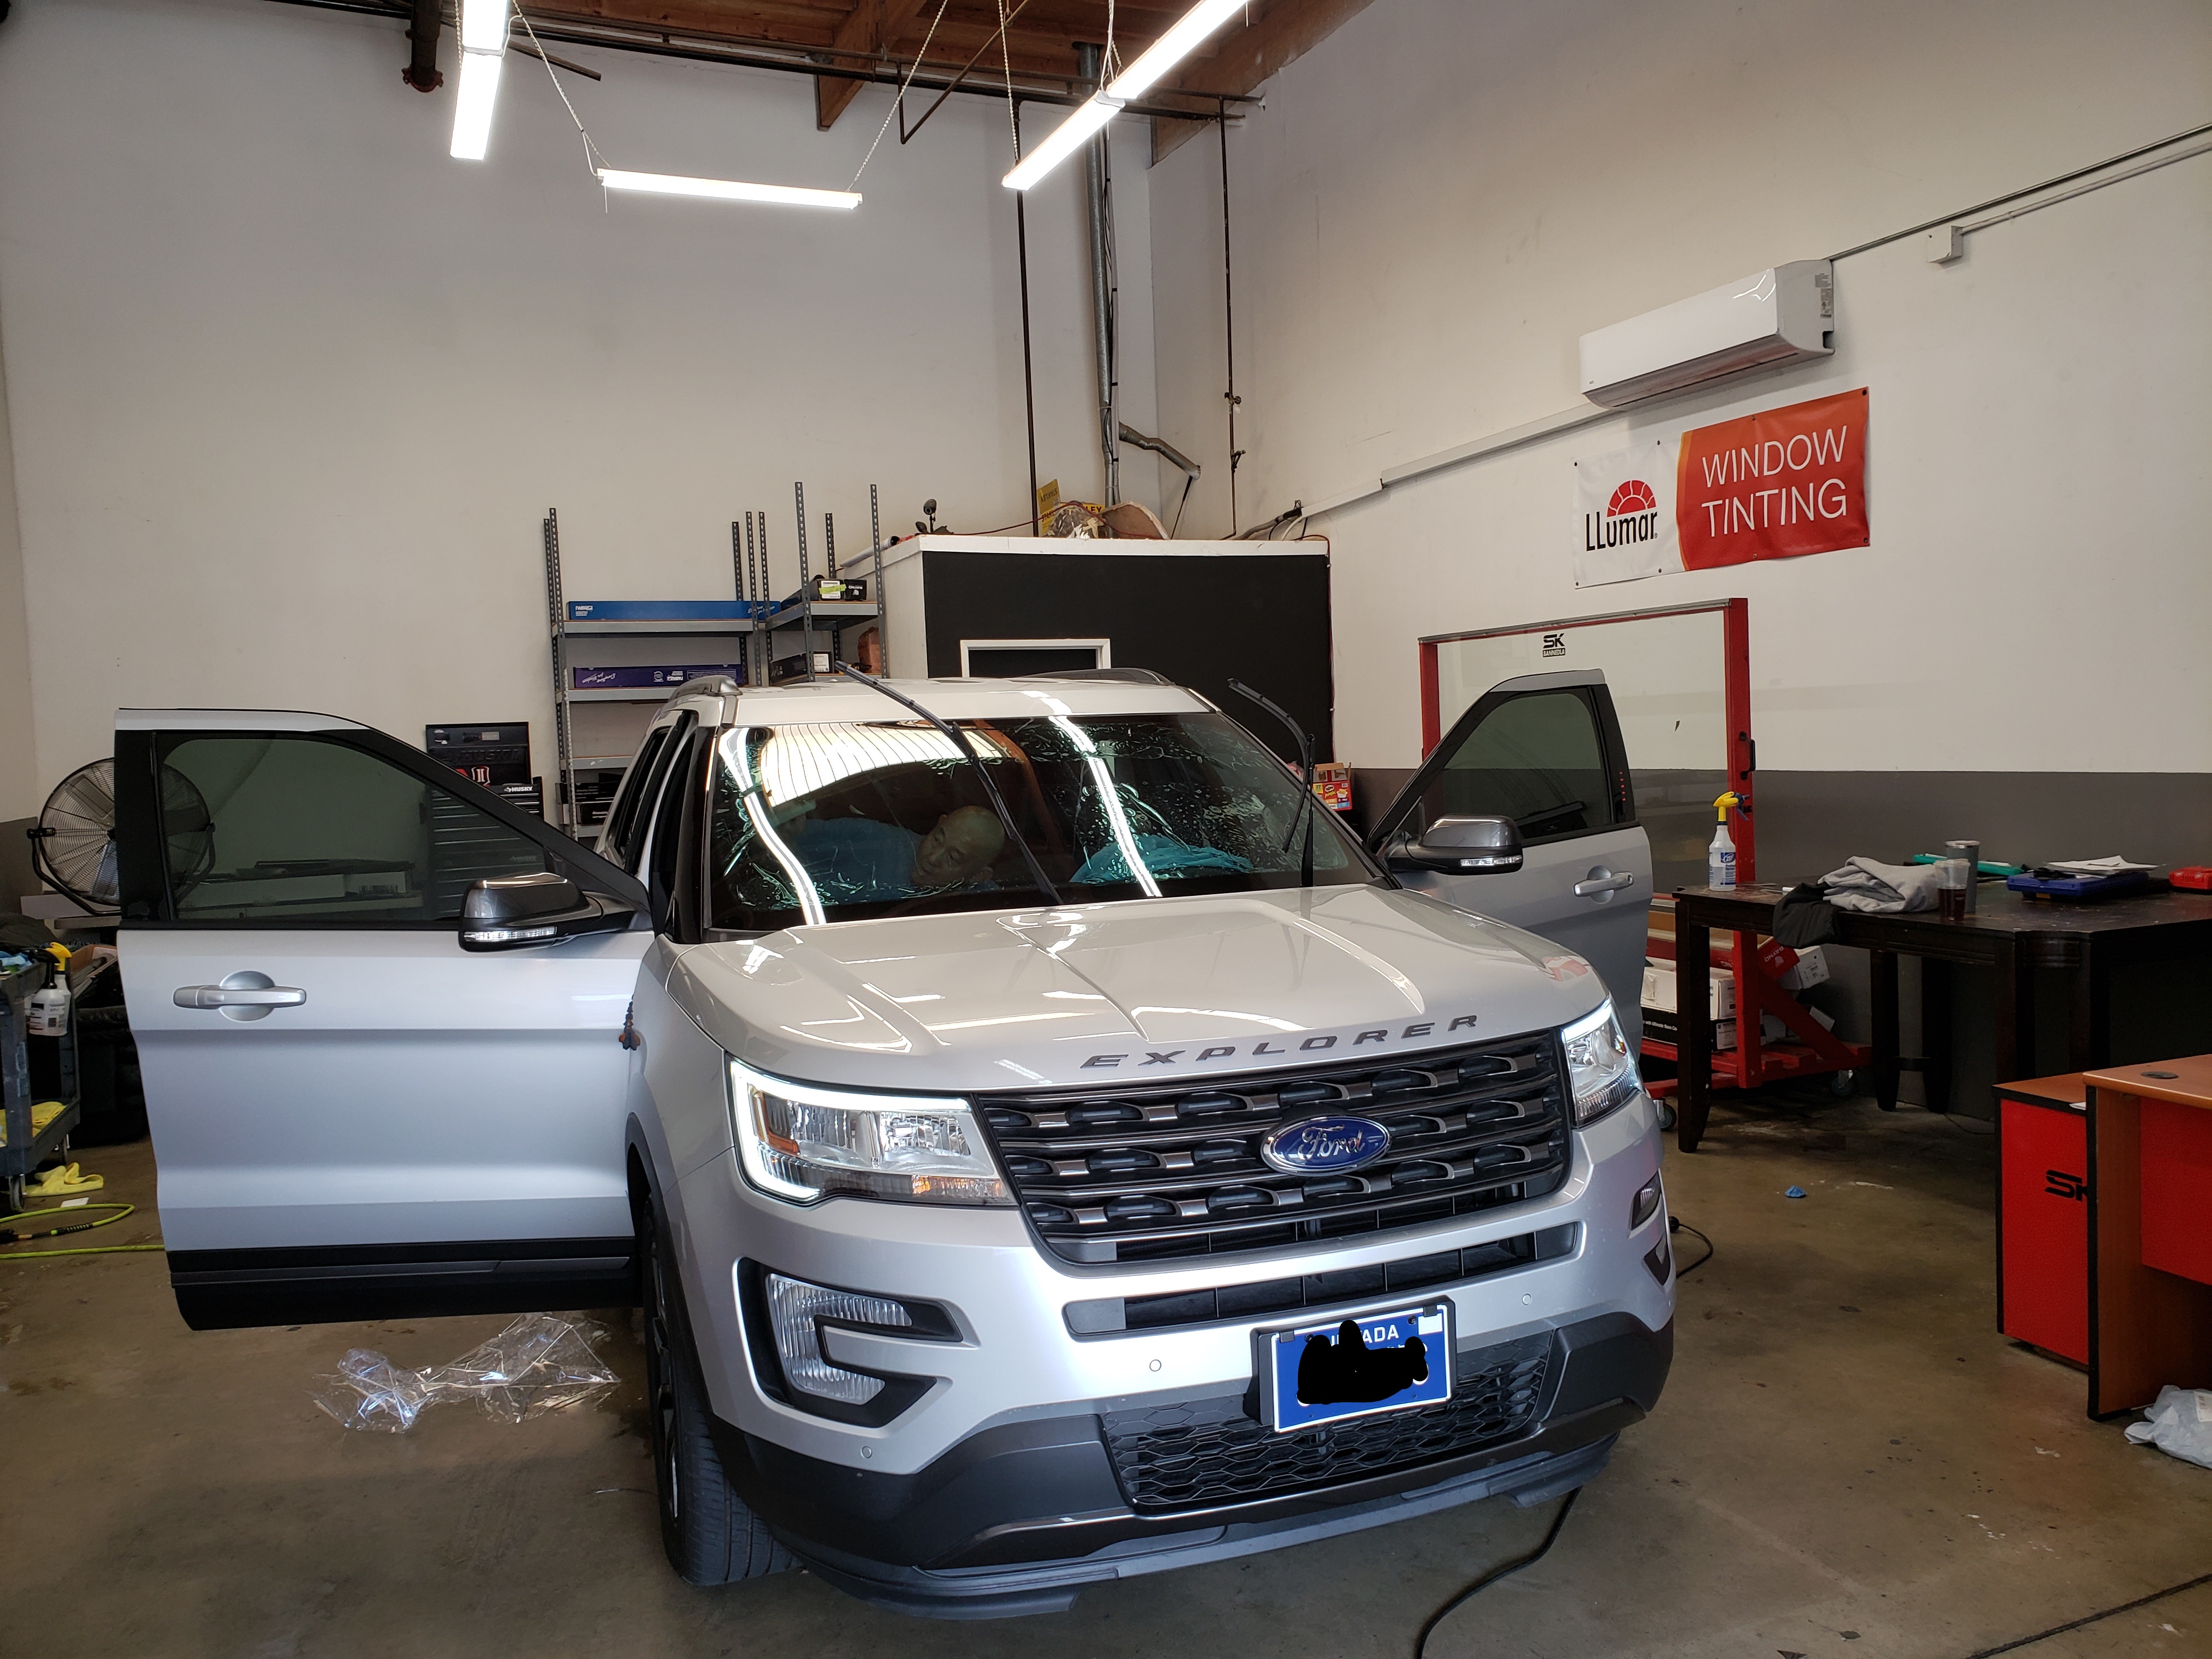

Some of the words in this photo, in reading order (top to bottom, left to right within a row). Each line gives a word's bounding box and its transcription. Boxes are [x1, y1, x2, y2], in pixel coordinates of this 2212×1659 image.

[1701, 425, 1847, 488] WINDOW
[1701, 478, 1847, 538] TINTING
[1585, 510, 1658, 552] LLumar
[1543, 633, 1565, 648] SK
[1764, 946, 1784, 962] RAYNO
[1080, 1014, 1478, 1069] EXPLORER
[1296, 1124, 1366, 1162] Ford
